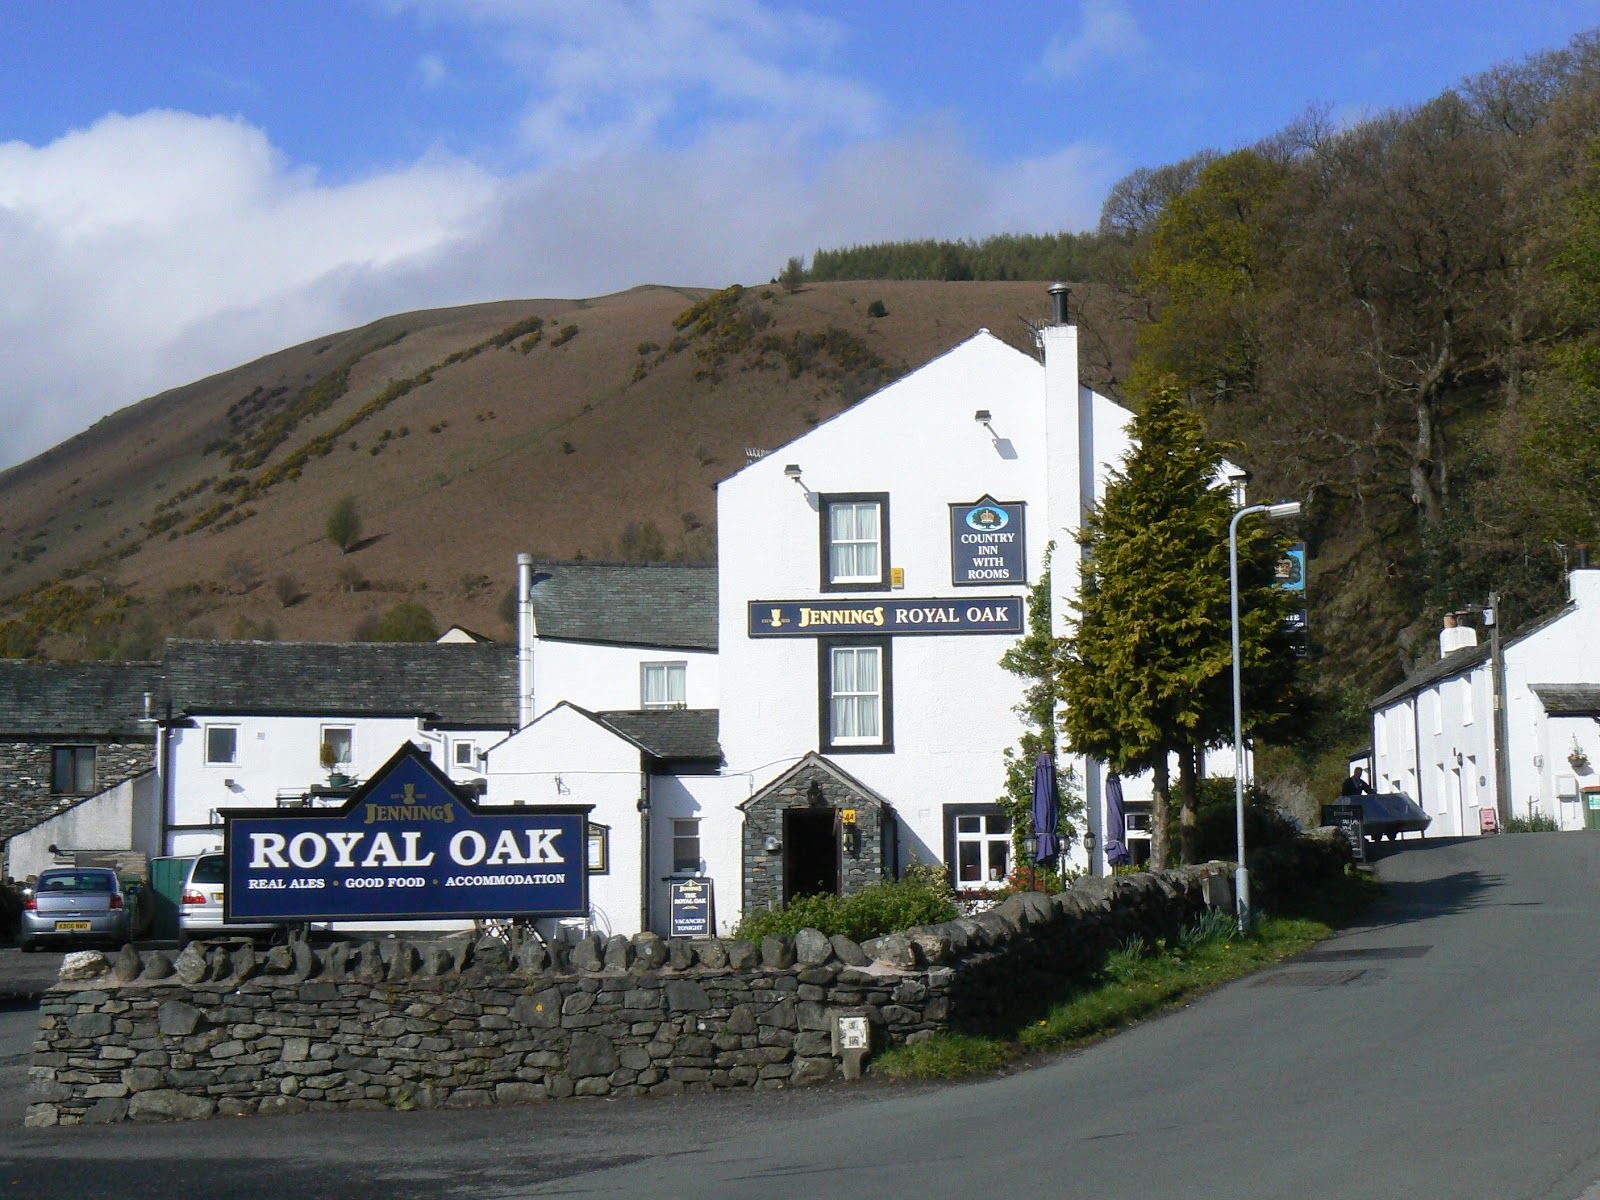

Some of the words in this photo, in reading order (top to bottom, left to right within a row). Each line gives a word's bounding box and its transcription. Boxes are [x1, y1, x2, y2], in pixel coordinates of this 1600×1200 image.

[961, 533, 1015, 544] COUNTRY
[978, 545, 998, 555] INN
[972, 557, 1004, 567] WITH
[968, 568, 1010, 579] ROOMS
[798, 606, 885, 628] JENNINGS
[895, 607, 960, 624] ROYAL
[966, 606, 1009, 622] OAK
[364, 802, 455, 824] JENNINGS
[249, 831, 436, 869] ROYAL
[449, 828, 565, 867] OAK
[248, 879, 287, 890] REAL
[289, 878, 326, 889] ALES
[345, 878, 385, 889] GOOD
[387, 877, 426, 888] FOOD
[445, 874, 566, 887] ACCOMMODATION
